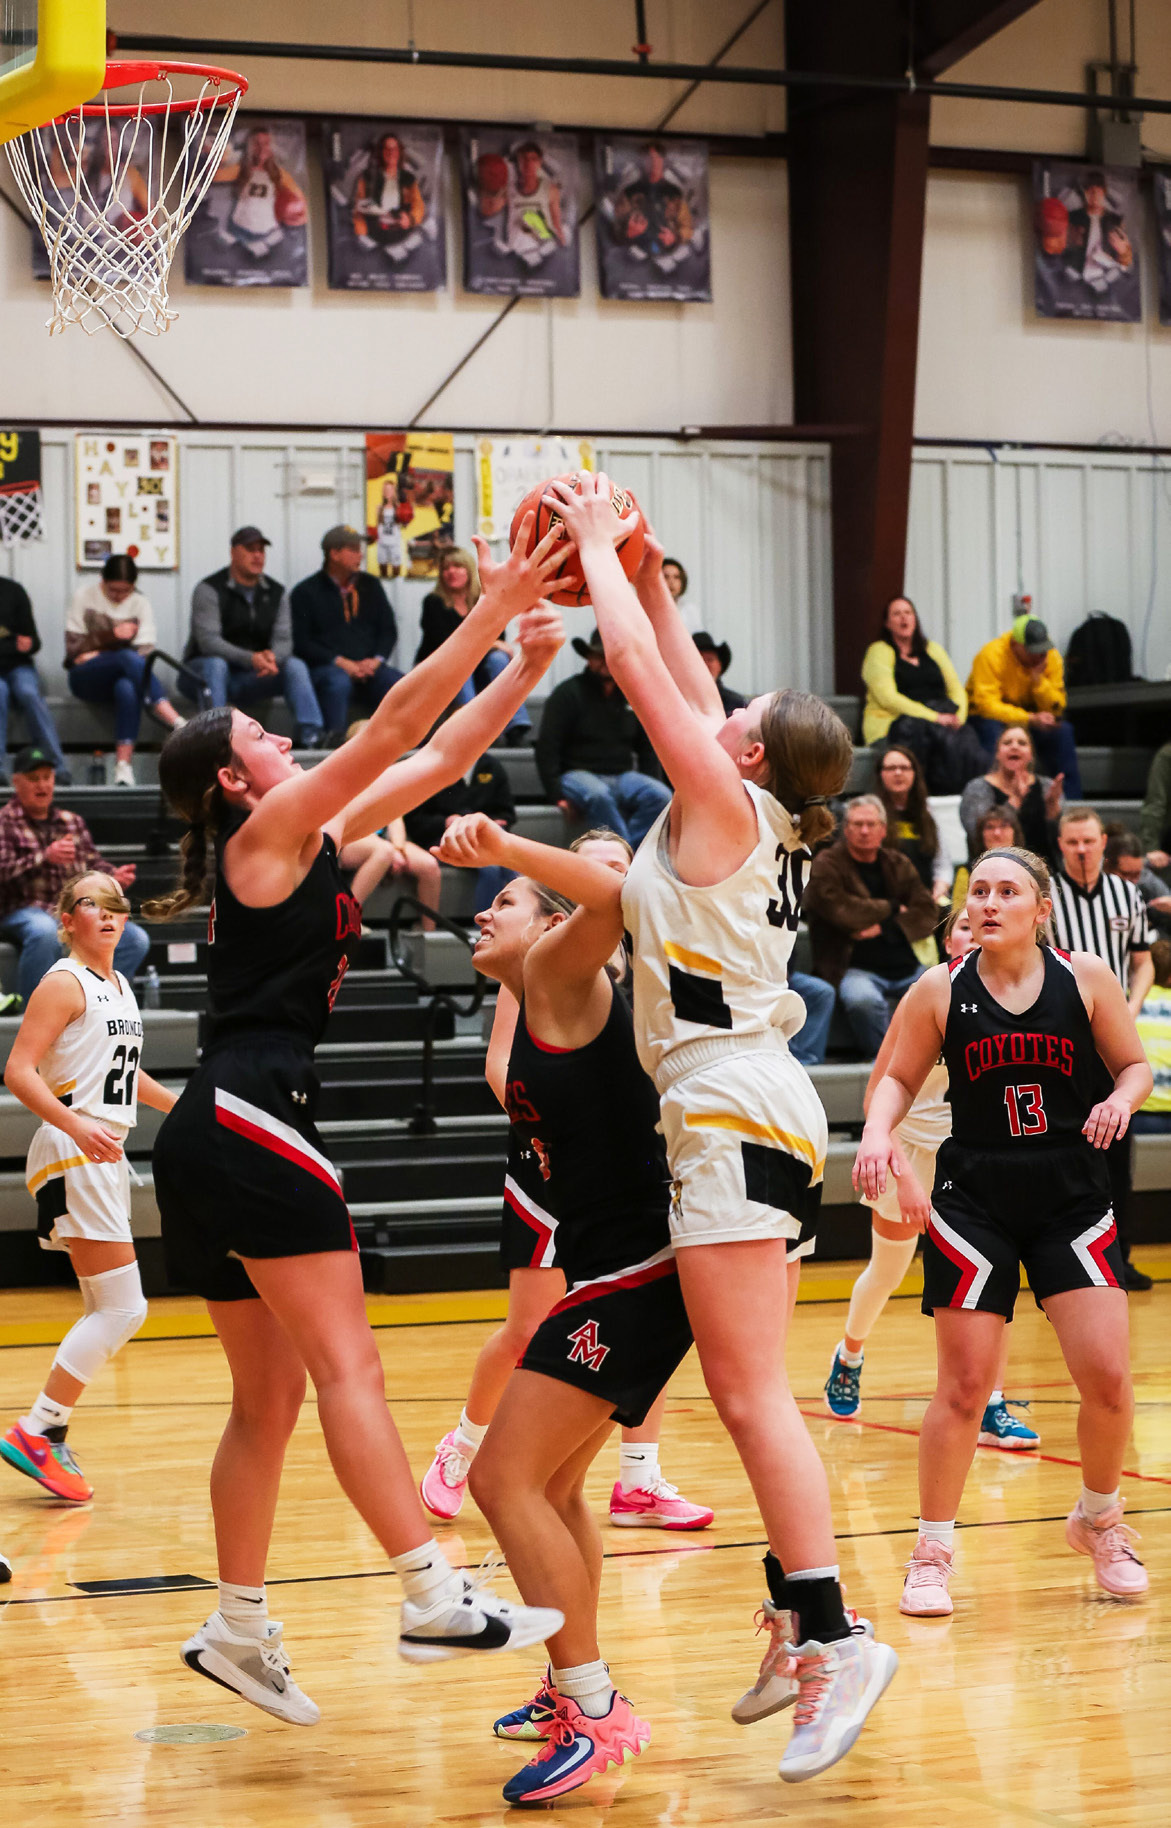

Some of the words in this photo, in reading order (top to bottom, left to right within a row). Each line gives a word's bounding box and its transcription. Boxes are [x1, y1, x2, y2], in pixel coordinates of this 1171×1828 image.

[103, 1044, 139, 1106] 22
[965, 1032, 1074, 1082] COYOTES
[1004, 1083, 1048, 1137] 13
[567, 1319, 611, 1372] AM
